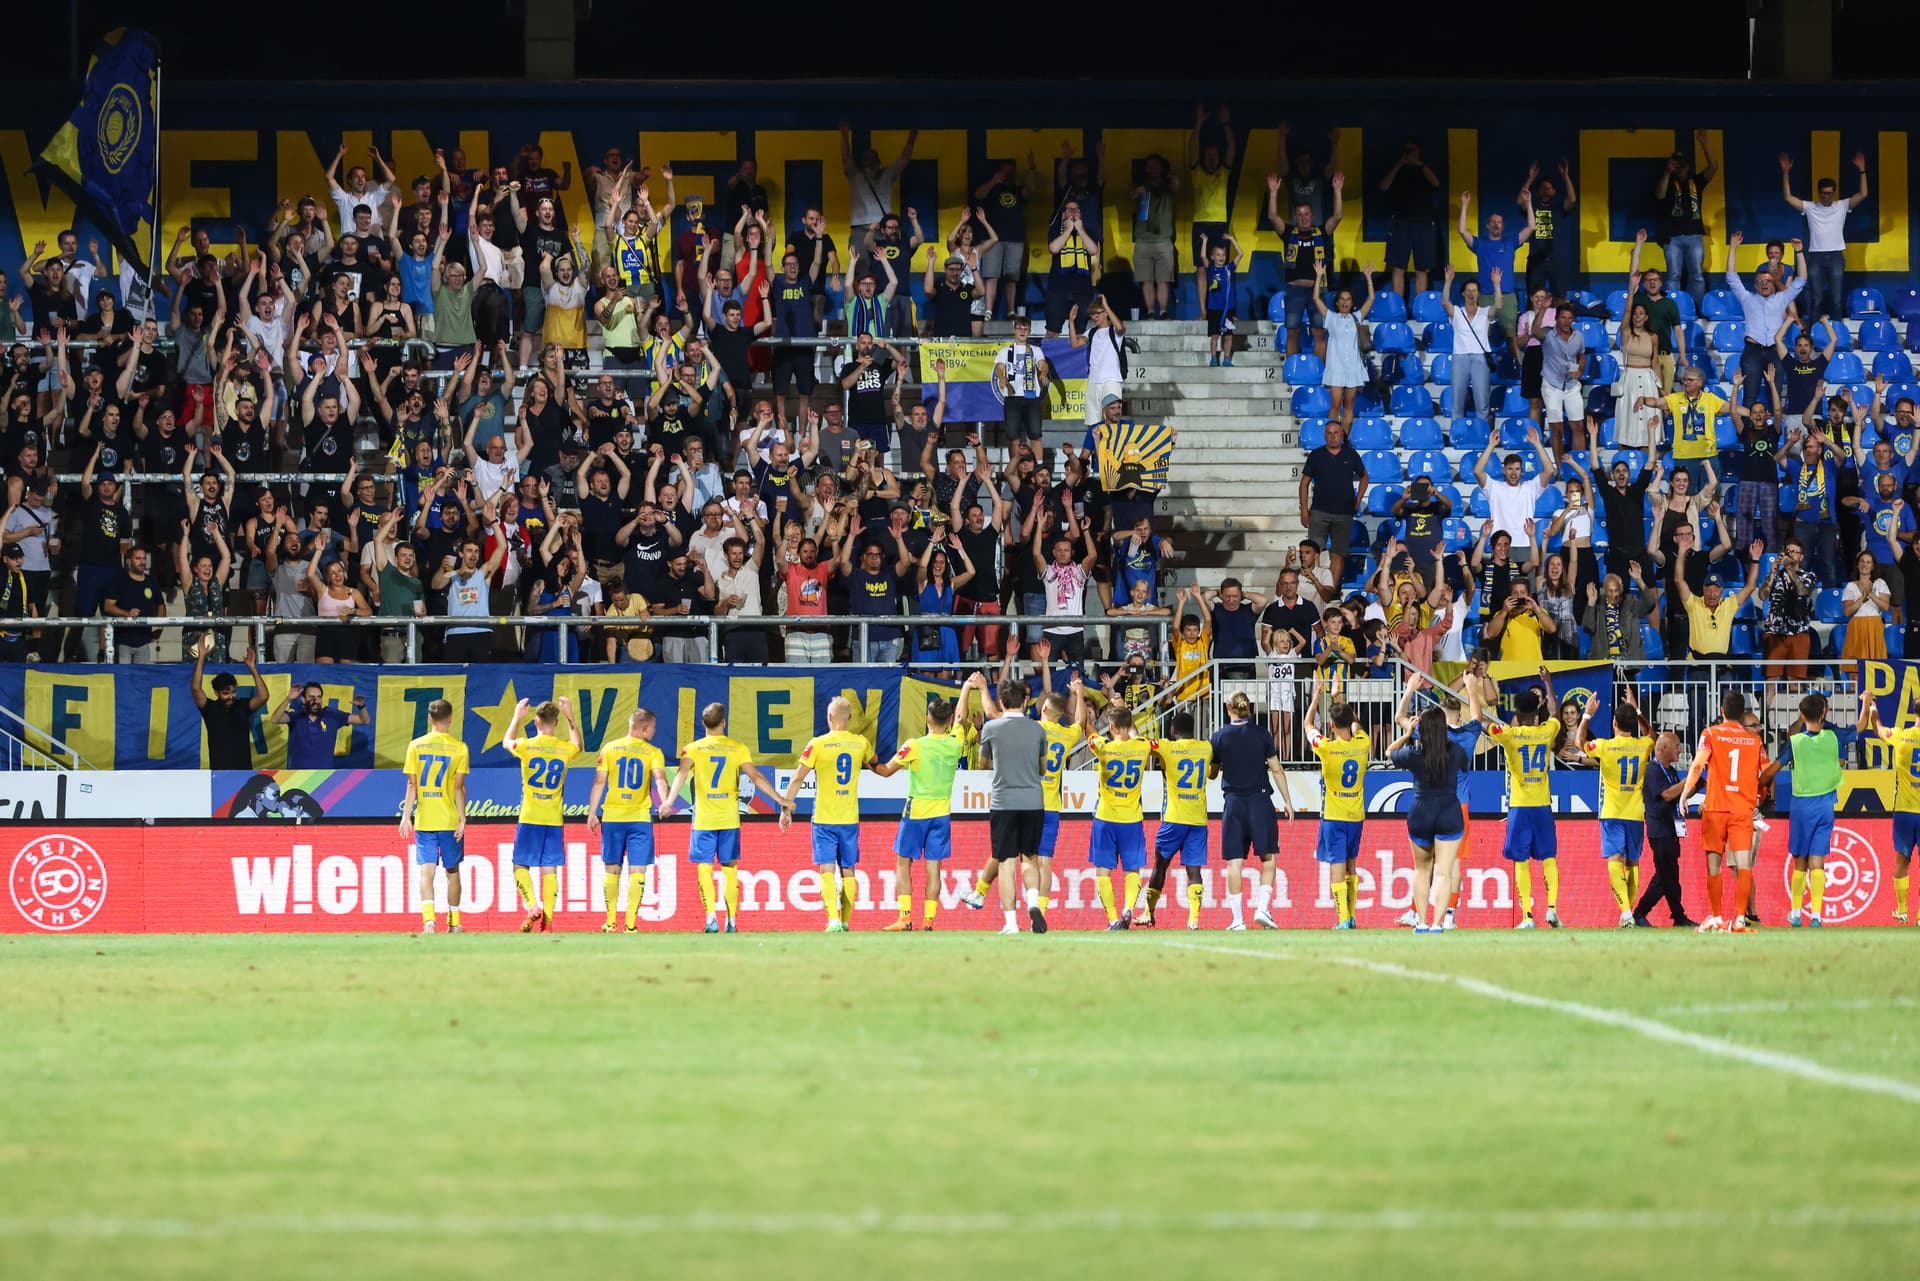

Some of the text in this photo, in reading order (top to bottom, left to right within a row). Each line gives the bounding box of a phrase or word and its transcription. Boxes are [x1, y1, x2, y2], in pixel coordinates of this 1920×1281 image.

[0, 129, 590, 275] VENNA
[929, 348, 998, 357] FIRST VIENNA
[1257, 337, 1267, 347] 13
[945, 359, 967, 368] 1894
[1135, 367, 1146, 379] 12
[1264, 368, 1275, 379] 12
[1272, 400, 1283, 410] 11
[1280, 432, 1292, 444] 10
[1291, 467, 1298, 478] 9
[1273, 665, 1292, 679] 894
[418, 754, 452, 788] 77
[615, 755, 644, 790] 10
[709, 756, 726, 789] 7
[835, 752, 853, 785] 9
[1046, 742, 1065, 773] 3
[1517, 743, 1548, 774] 14
[1616, 755, 1640, 785] 11
[1728, 748, 1740, 782] 1
[527, 756, 565, 790] 28
[1106, 759, 1143, 789] 25
[1176, 758, 1205, 790] 21
[1341, 759, 1359, 788] 8
[25, 841, 84, 866] SEIT
[20, 878, 102, 925] JAHREN
[1138, 866, 1293, 909] zum
